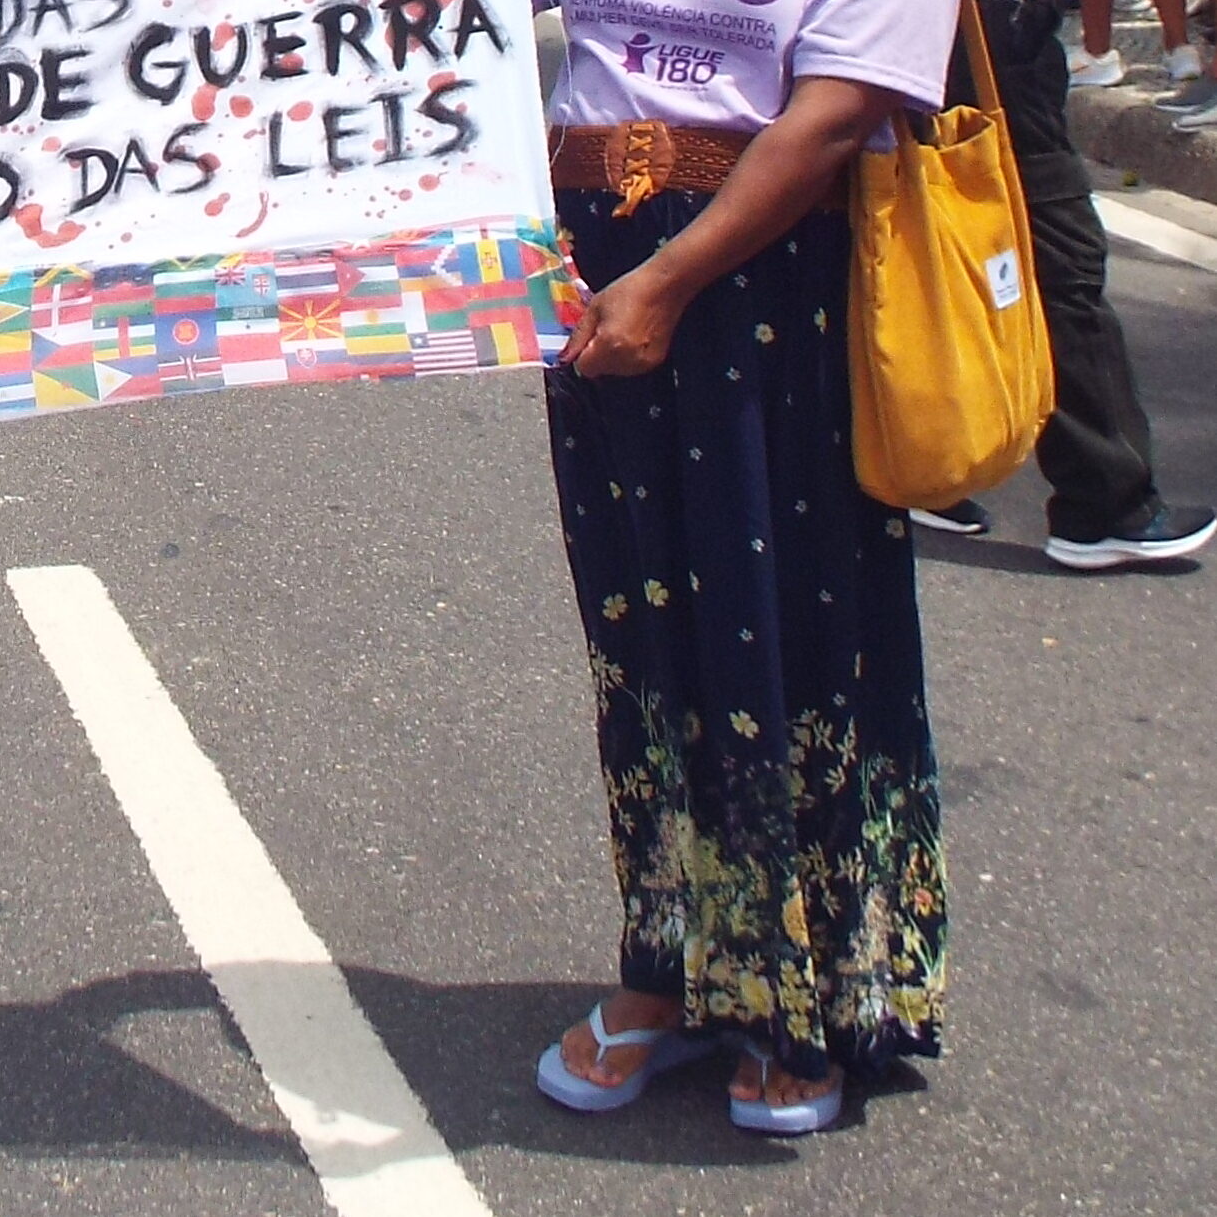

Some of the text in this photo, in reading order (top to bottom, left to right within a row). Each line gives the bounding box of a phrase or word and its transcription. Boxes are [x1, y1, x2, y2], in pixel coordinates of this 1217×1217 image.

[710, 12, 777, 36] CONTRA
[658, 43, 726, 65] LIGUE
[656, 56, 718, 85] 180
[60, 122, 217, 216] DAS
[265, 79, 482, 181] LEIS
